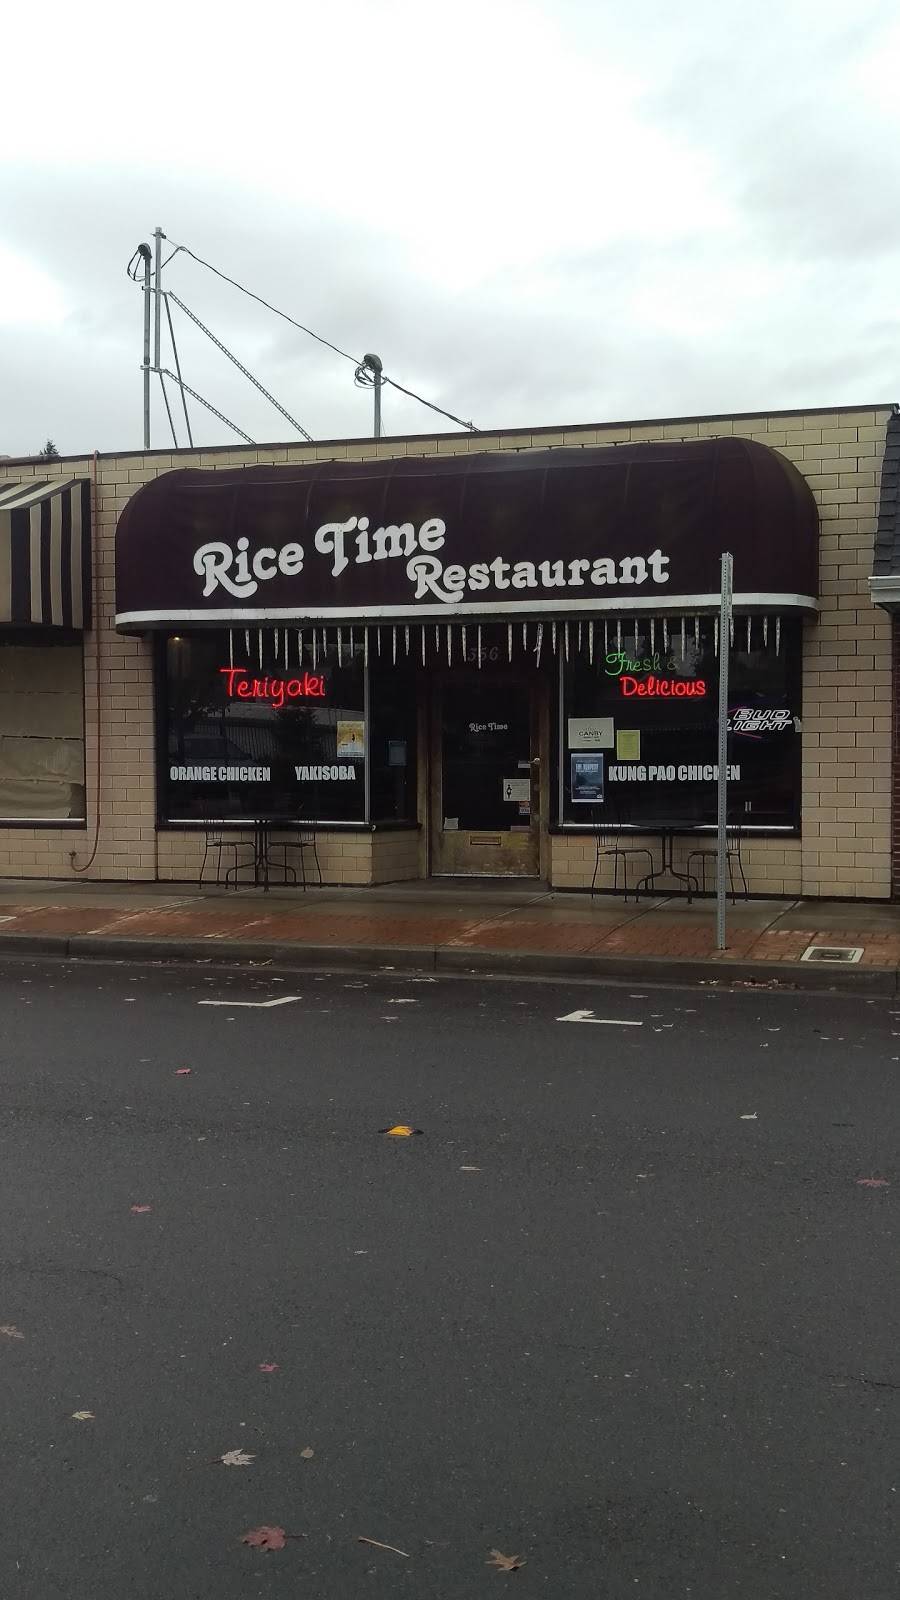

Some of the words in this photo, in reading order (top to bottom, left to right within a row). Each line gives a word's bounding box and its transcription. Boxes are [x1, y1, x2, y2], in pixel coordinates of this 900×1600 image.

[193, 537, 304, 598] Rice
[315, 516, 446, 576] Time
[406, 549, 670, 603] Restaurant
[606, 652, 661, 676] Fresh
[220, 667, 326, 708] Teriyaki
[620, 676, 706, 697] Delicious
[733, 709, 790, 720] BUD
[469, 722, 487, 732] Rice
[488, 722, 508, 731] Time
[170, 766, 217, 781] ORANGE
[218, 767, 271, 781] CHICKEN
[295, 766, 355, 781] YAKISOBA
[608, 766, 646, 781] KUNG
[648, 765, 675, 781] PAO
